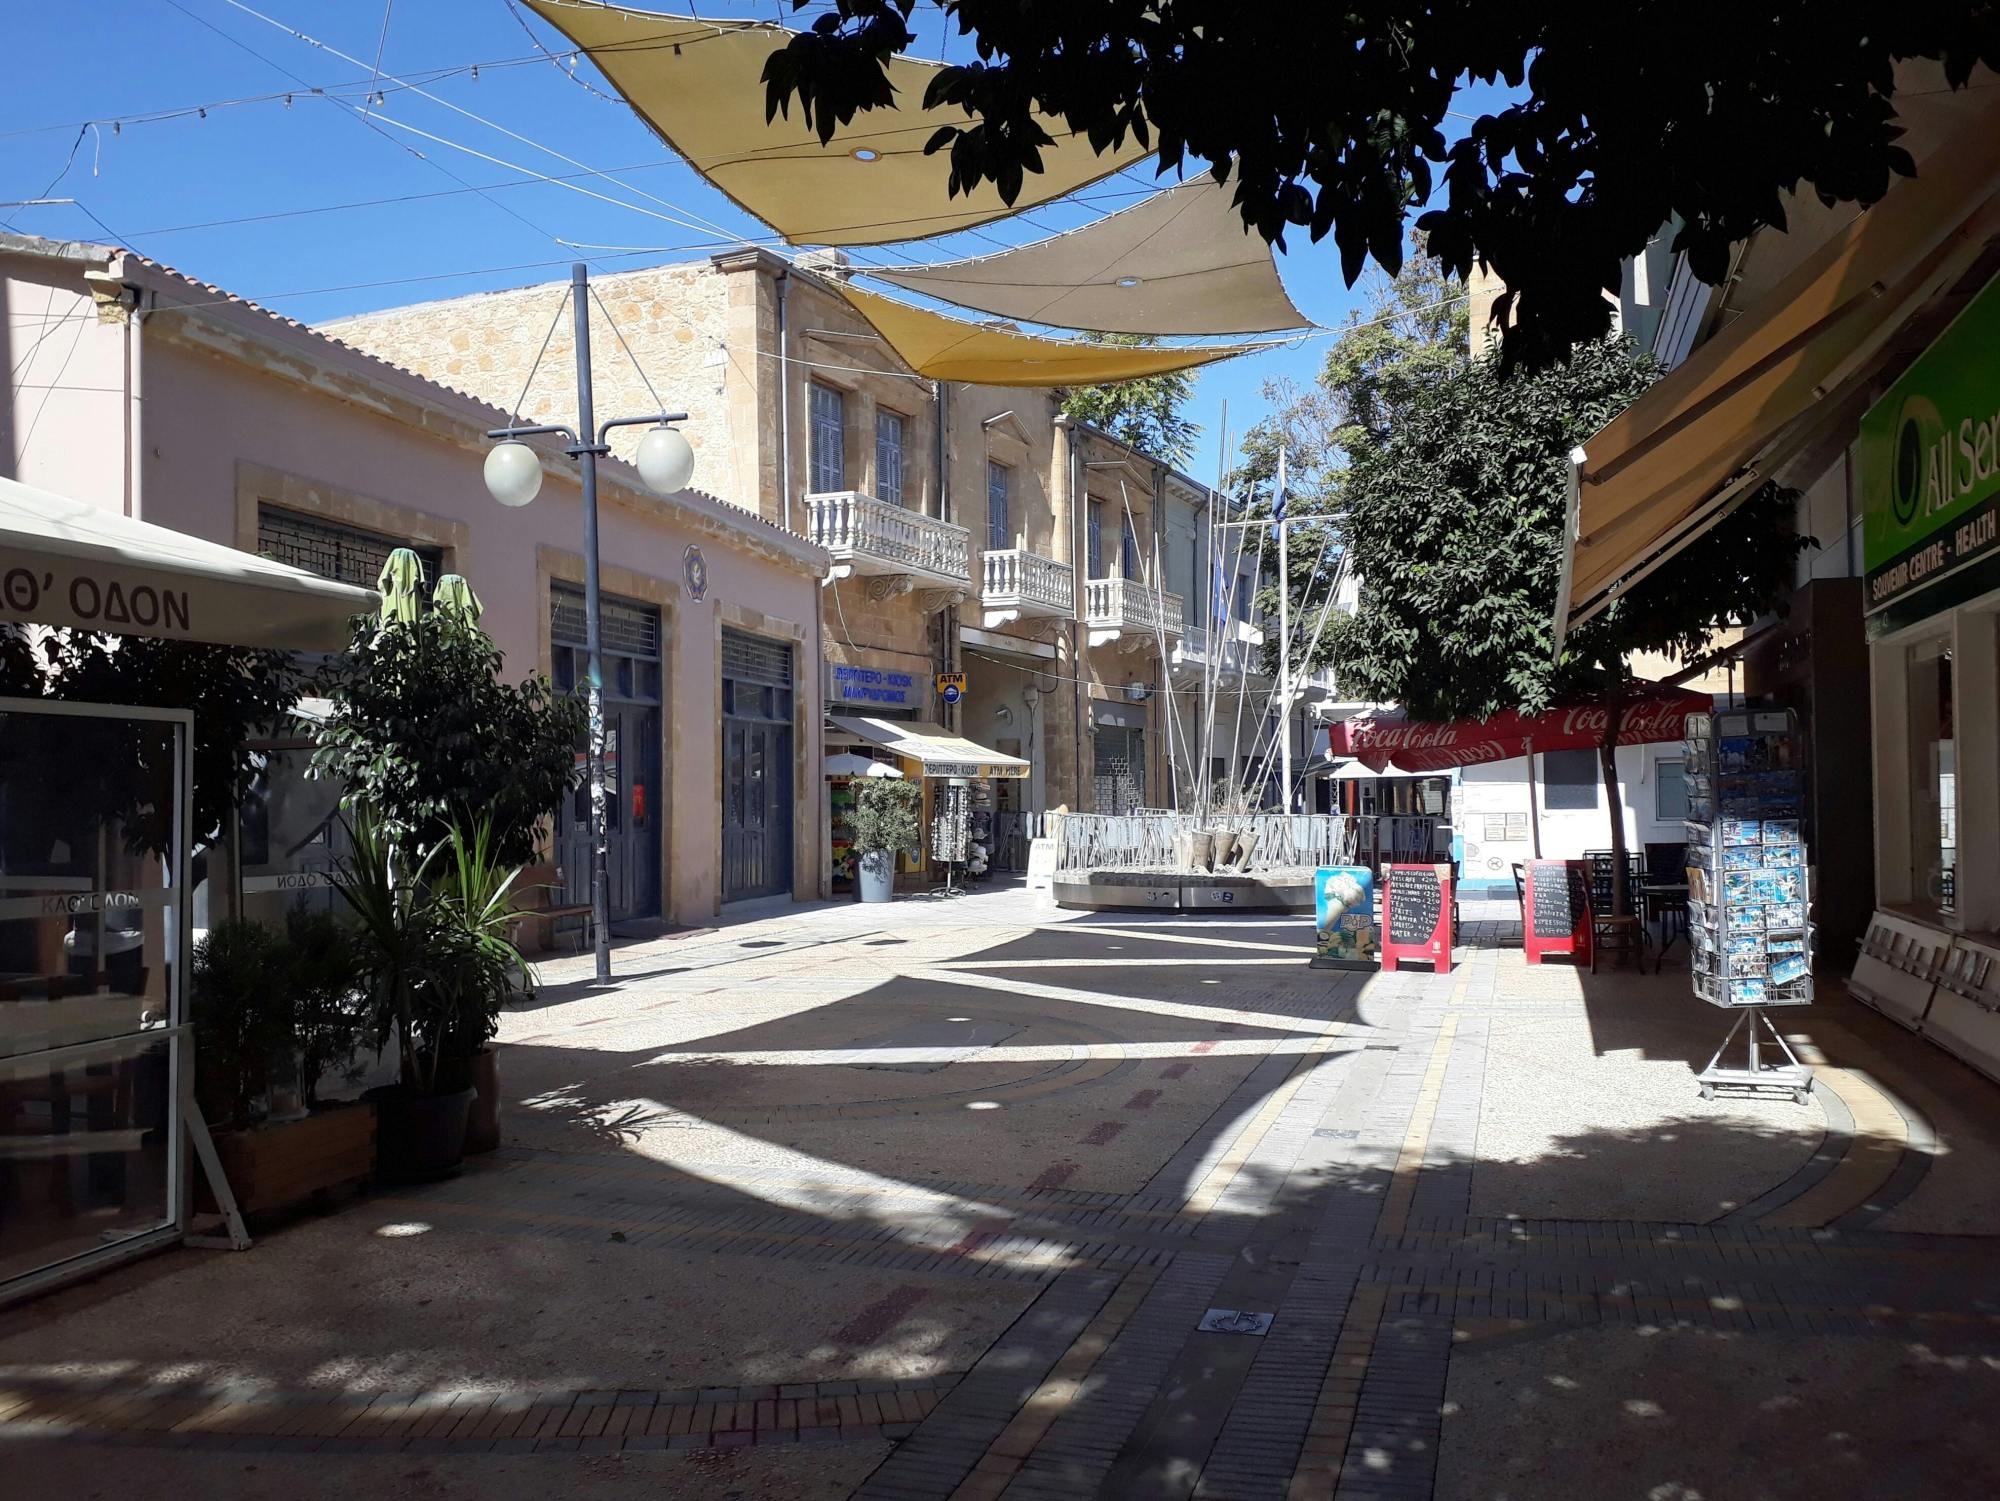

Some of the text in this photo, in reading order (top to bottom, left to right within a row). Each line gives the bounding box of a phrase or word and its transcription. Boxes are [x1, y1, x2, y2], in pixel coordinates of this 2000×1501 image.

[1925, 430, 1955, 517] All
[1872, 561, 1907, 601] SOUVENIR
[1909, 539, 1945, 582] CENTRE
[1955, 508, 1997, 557] HEALTH
[0, 568, 190, 630] Θ' ΟΔΟΝ
[887, 673, 912, 688] KIOSK
[940, 675, 963, 683] ATM
[924, 763, 958, 776] ΠΕΡΙΠΤΕΡΟ
[961, 764, 978, 776] KIOSK
[989, 766, 1021, 776] ATM HERE
